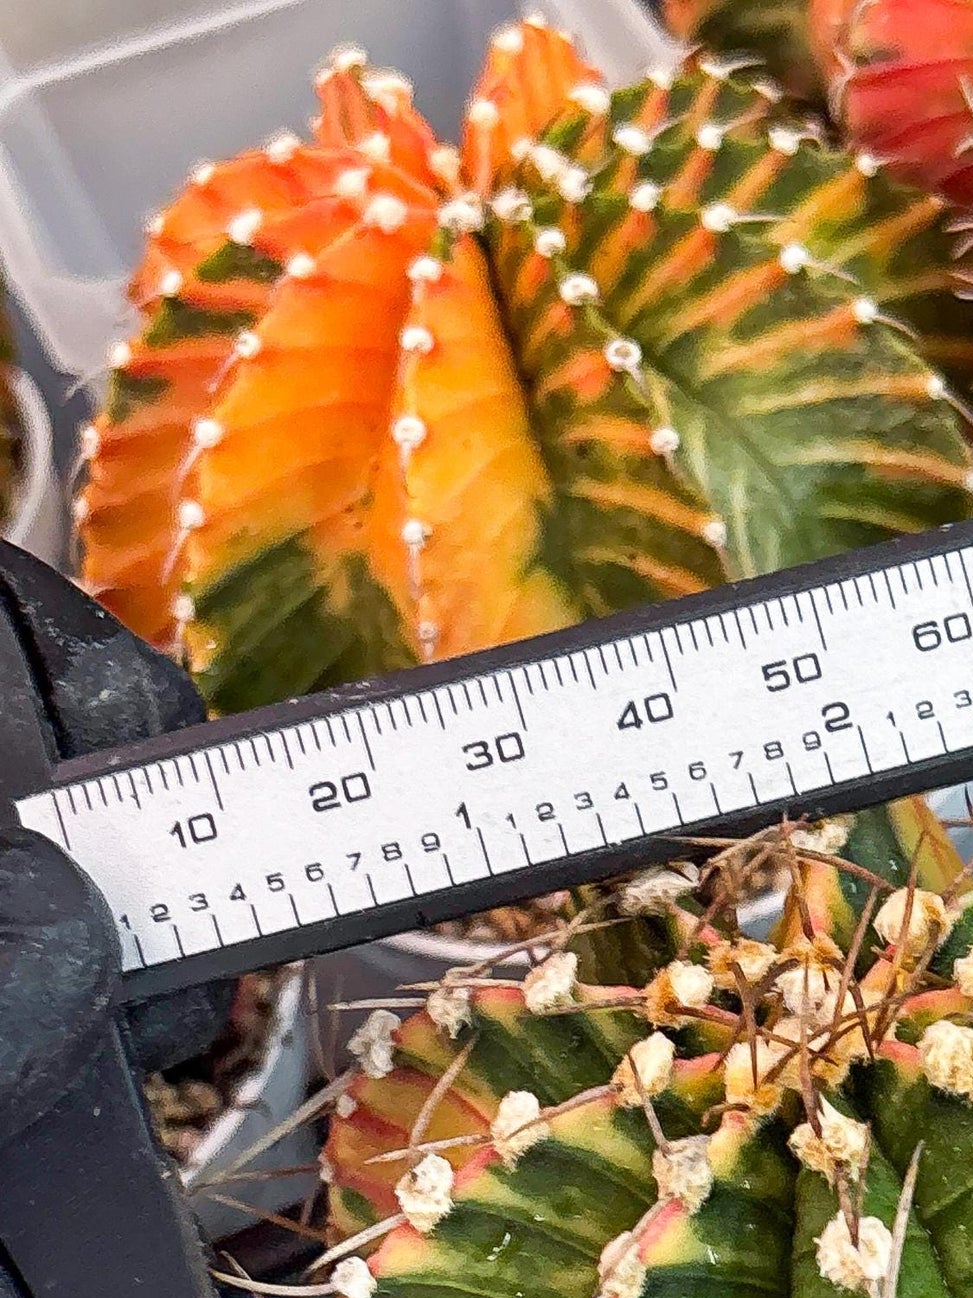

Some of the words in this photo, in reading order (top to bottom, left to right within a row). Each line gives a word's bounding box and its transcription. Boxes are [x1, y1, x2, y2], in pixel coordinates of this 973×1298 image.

[119, 914, 132, 930] 1
[149, 903, 171, 923] 2
[189, 893, 209, 912] 3
[229, 883, 247, 901] 4
[265, 872, 285, 893] 5
[304, 862, 325, 882] 6
[345, 852, 362, 871] 7
[381, 841, 403, 862] 8
[421, 832, 441, 853] 9
[455, 801, 472, 830] 1
[505, 812, 517, 829] 1
[535, 802, 556, 822] 2
[573, 791, 594, 811] 3
[613, 782, 630, 800] 4
[649, 771, 668, 791] 5
[688, 761, 707, 781] 6
[729, 750, 744, 770] 7
[763, 741, 784, 761] 8
[802, 731, 822, 752] 9
[821, 701, 853, 733] 2
[886, 710, 897, 728] 1
[915, 700, 935, 720] 2
[954, 689, 973, 709] 3
[170, 812, 218, 849] 10
[308, 772, 372, 813] 20
[462, 732, 526, 771] 30
[616, 692, 674, 731] 40
[761, 652, 823, 693] 50
[912, 612, 973, 652] 60
